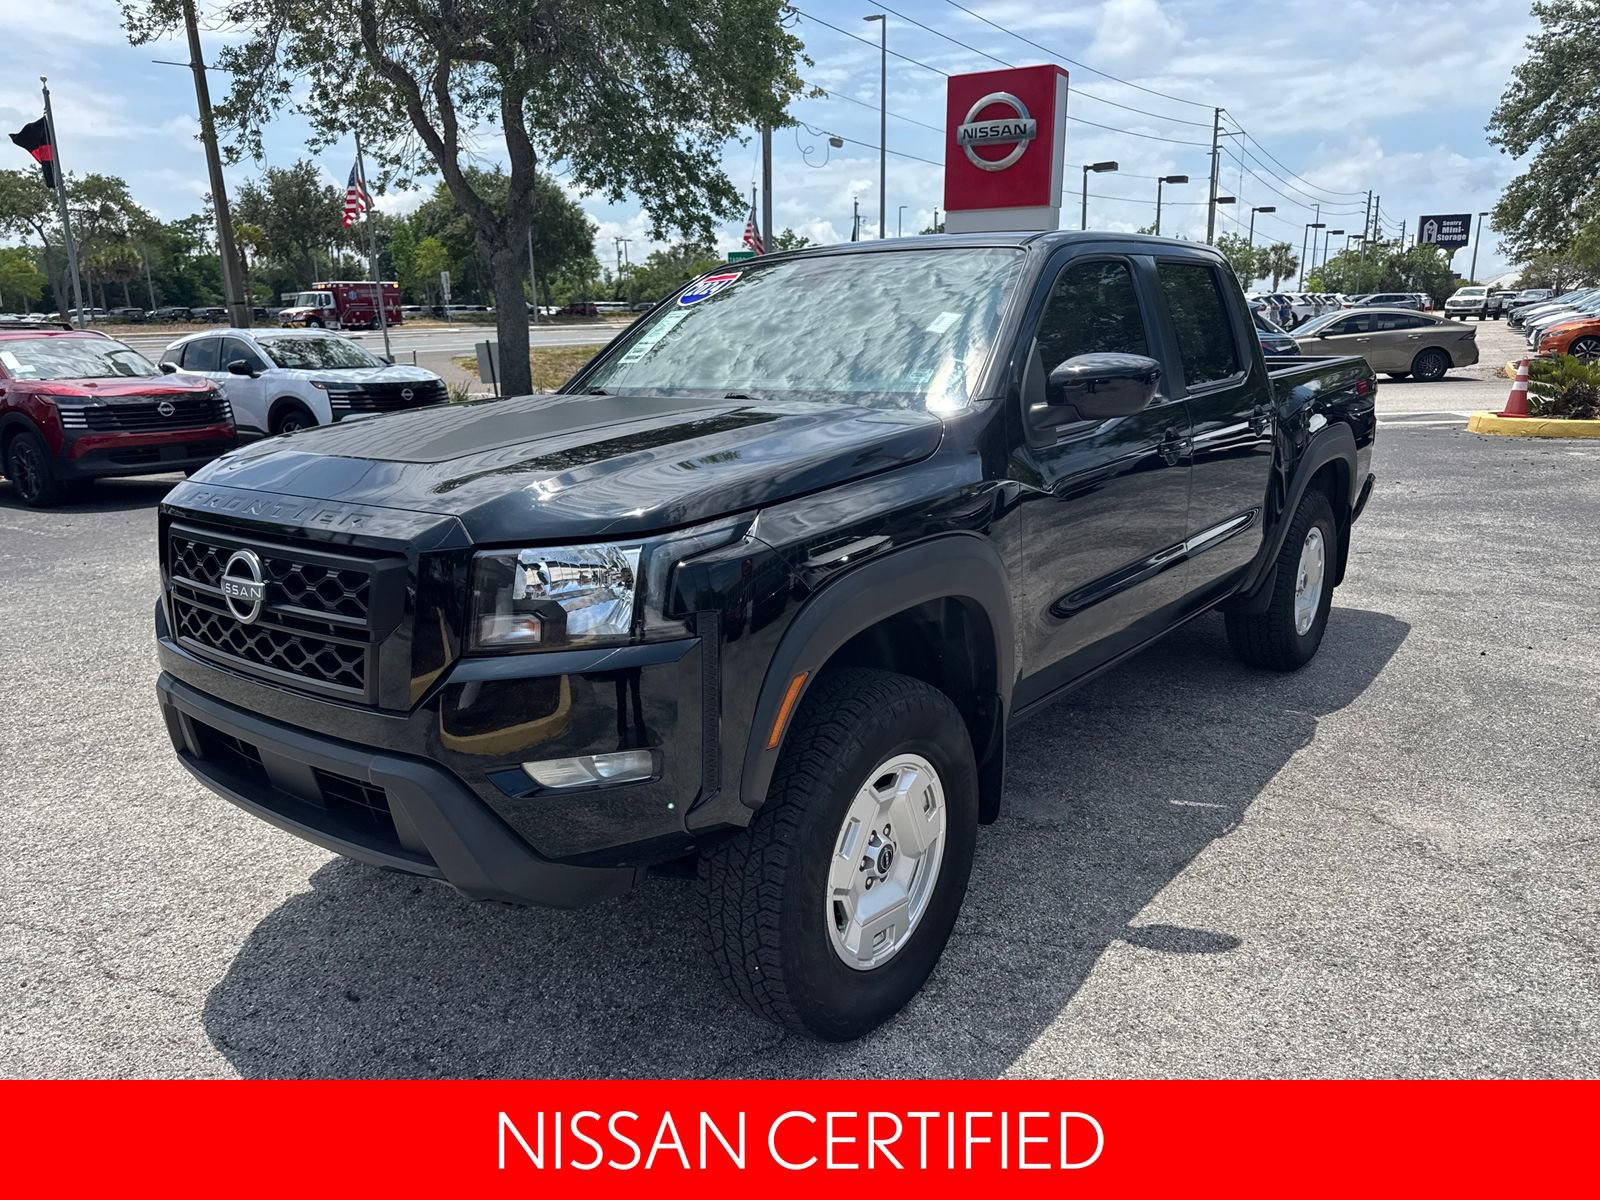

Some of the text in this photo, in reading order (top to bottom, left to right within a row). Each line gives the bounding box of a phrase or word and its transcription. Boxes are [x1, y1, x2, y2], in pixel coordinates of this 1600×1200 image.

[962, 123, 1027, 140] NISSAN
[1441, 226, 1465, 234] Mini-
[187, 490, 375, 528] FRONTIER
